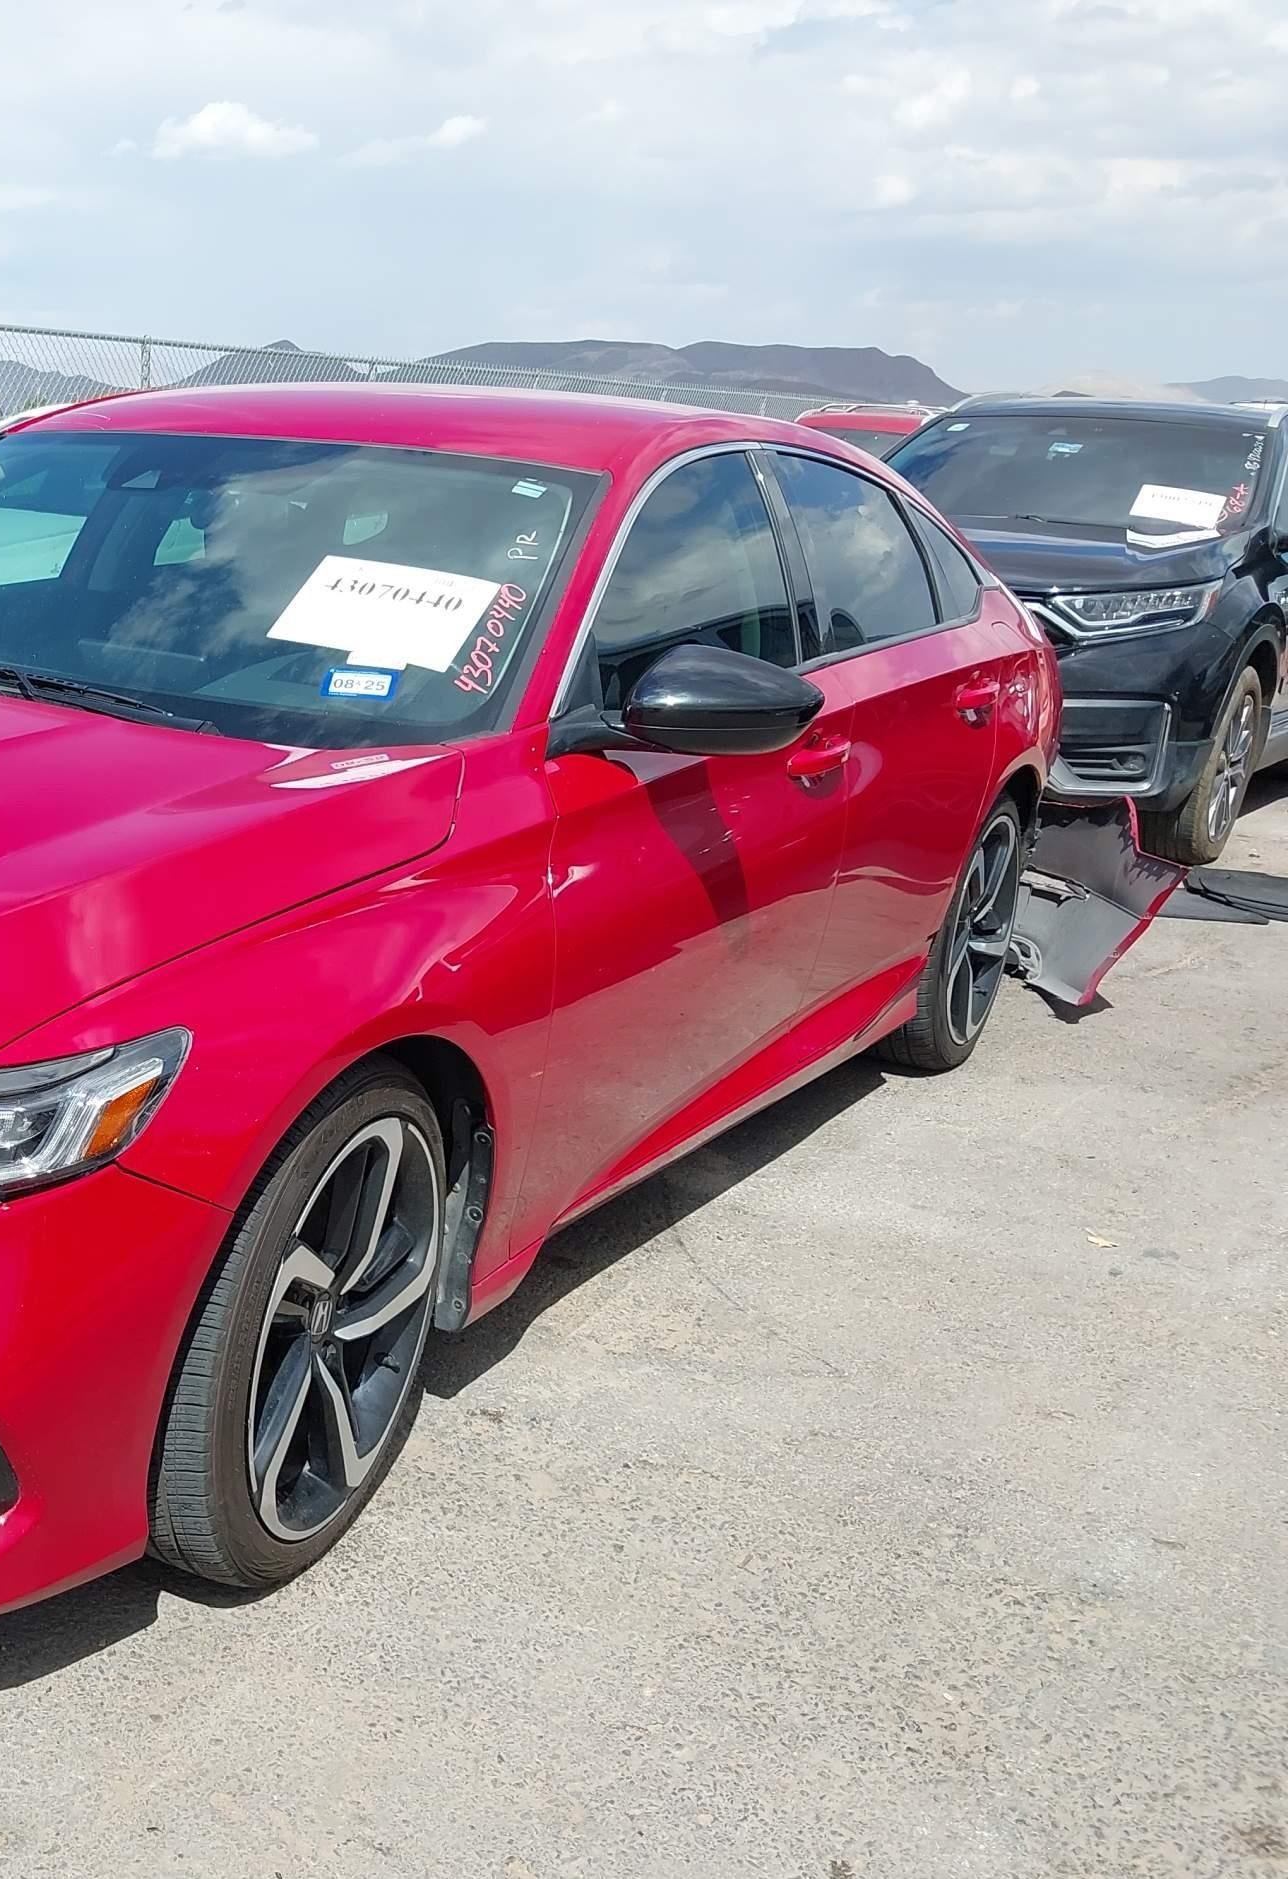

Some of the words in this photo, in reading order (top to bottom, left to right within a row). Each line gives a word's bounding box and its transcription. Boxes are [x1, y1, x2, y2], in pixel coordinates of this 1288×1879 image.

[507, 530, 539, 560] PR
[324, 577, 464, 612] 43070440
[454, 583, 527, 694] 43070440
